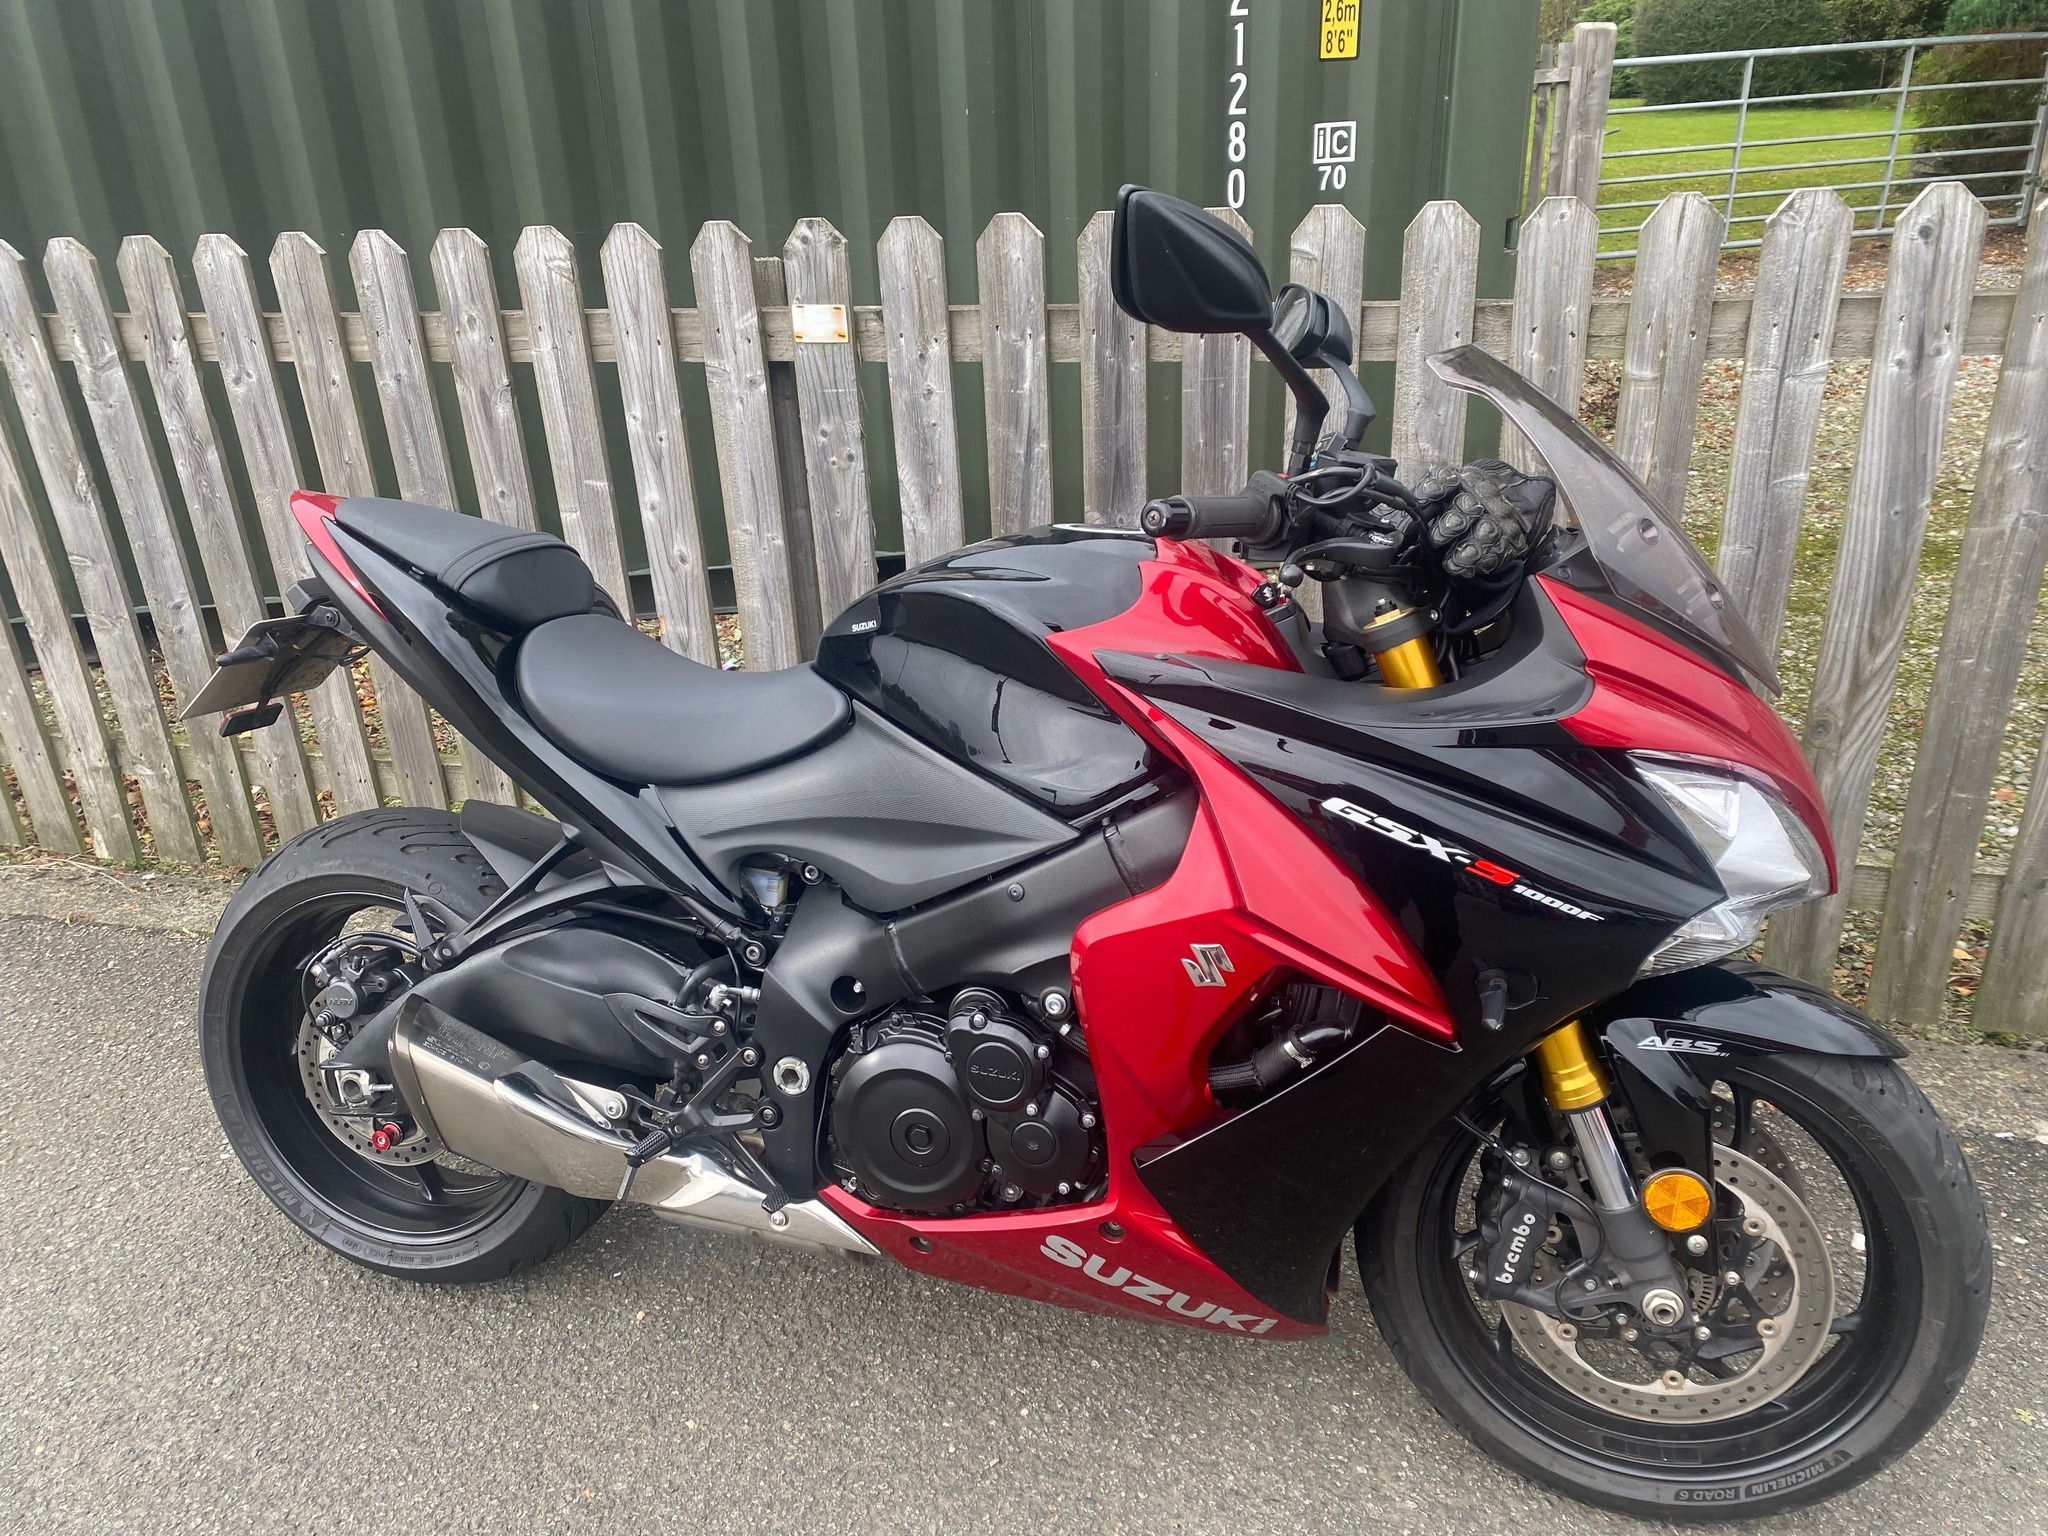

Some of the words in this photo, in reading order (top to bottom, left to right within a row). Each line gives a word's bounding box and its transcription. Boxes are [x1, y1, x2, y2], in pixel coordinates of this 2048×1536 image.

[1318, 164, 1347, 191] 70
[851, 619, 878, 633] SUZUKI
[1637, 1035, 1723, 1053] ABS
[1495, 1213, 1537, 1284] brembo
[1040, 1234, 1279, 1335] SUZUKI
[1751, 1463, 1826, 1495] MICHELIN
[1679, 1490, 1689, 1501] 6
[1693, 1487, 1736, 1501] ROAD
